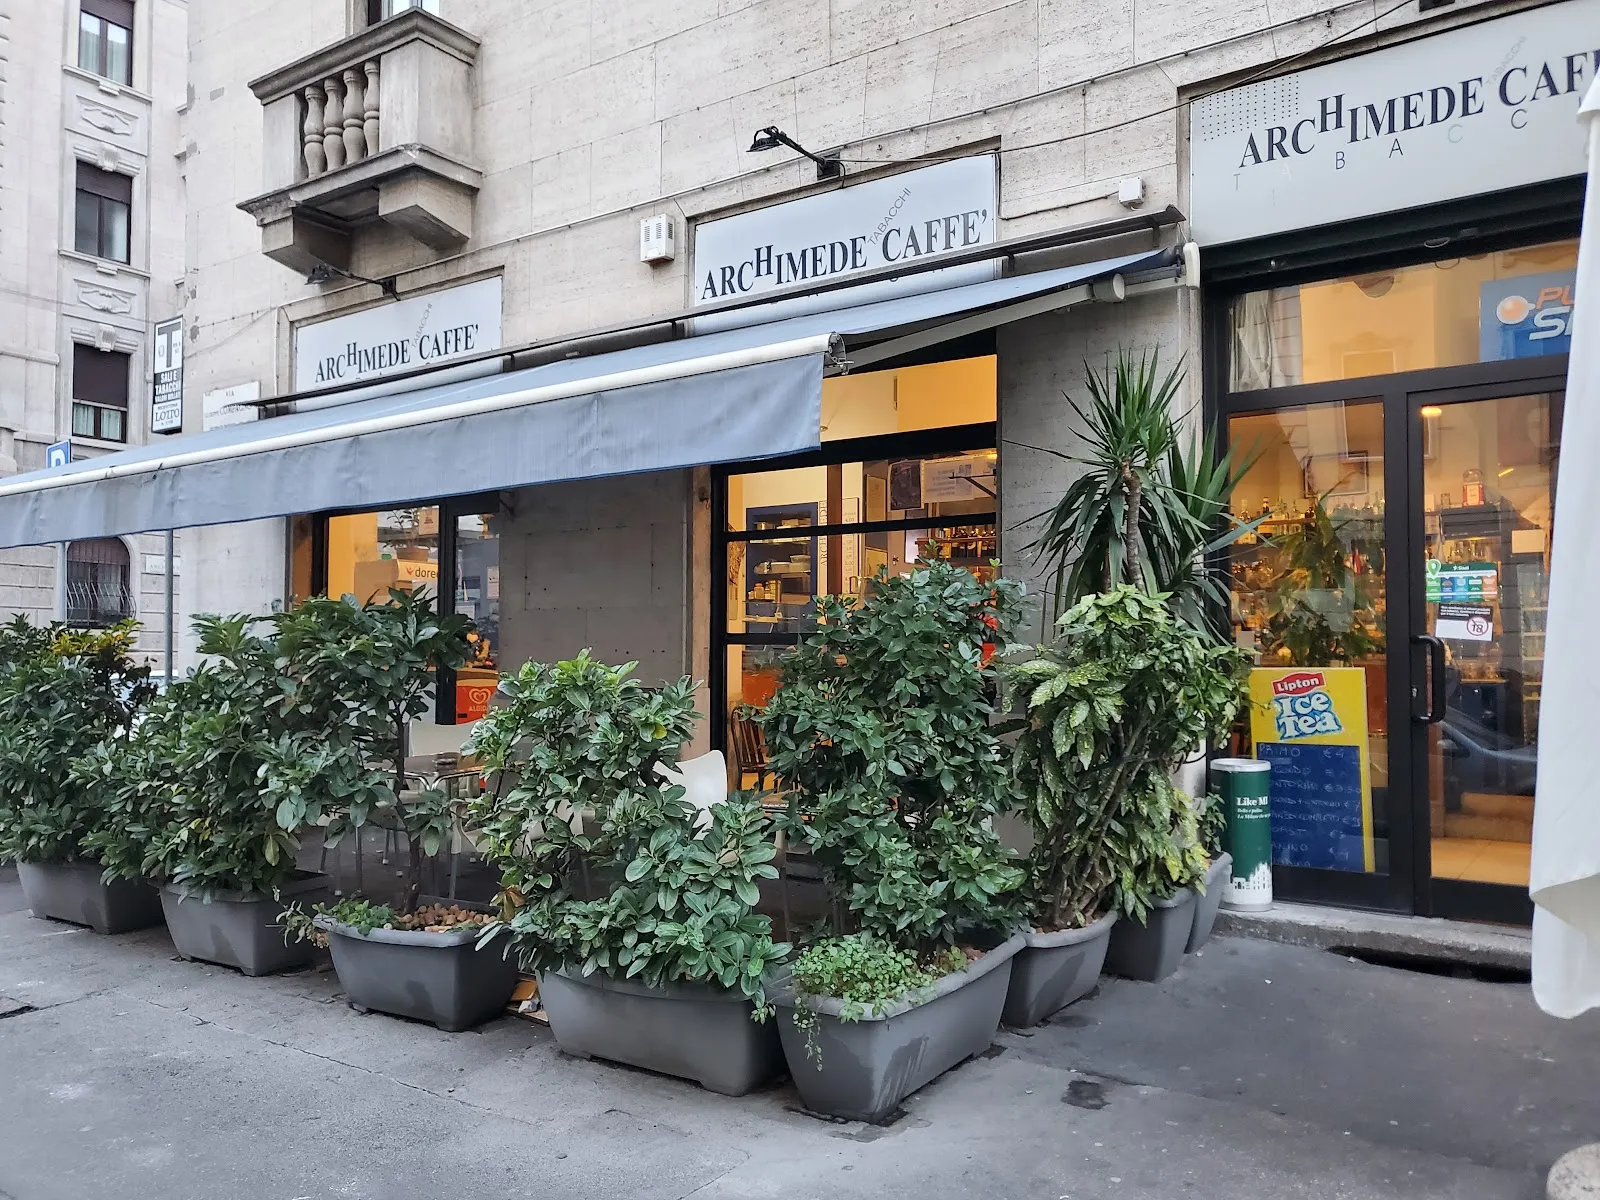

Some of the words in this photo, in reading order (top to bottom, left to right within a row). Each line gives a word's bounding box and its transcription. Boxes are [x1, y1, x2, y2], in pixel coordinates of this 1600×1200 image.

[1238, 76, 1485, 168] ARCHIMEDE
[868, 187, 912, 246] TABACCHI
[701, 234, 868, 301] ARCHIMEDE
[411, 302, 433, 348] TABACCHI
[158, 321, 181, 368] T
[314, 338, 411, 384] ARCHIMEDE
[155, 408, 180, 422] LOTTO
[414, 567, 438, 579] dore
[1471, 624, 1485, 633] 18
[1276, 677, 1320, 692] Lipton
[1277, 692, 1330, 718] Ice
[1278, 711, 1340, 739] Tea
[1236, 796, 1258, 806] Like
